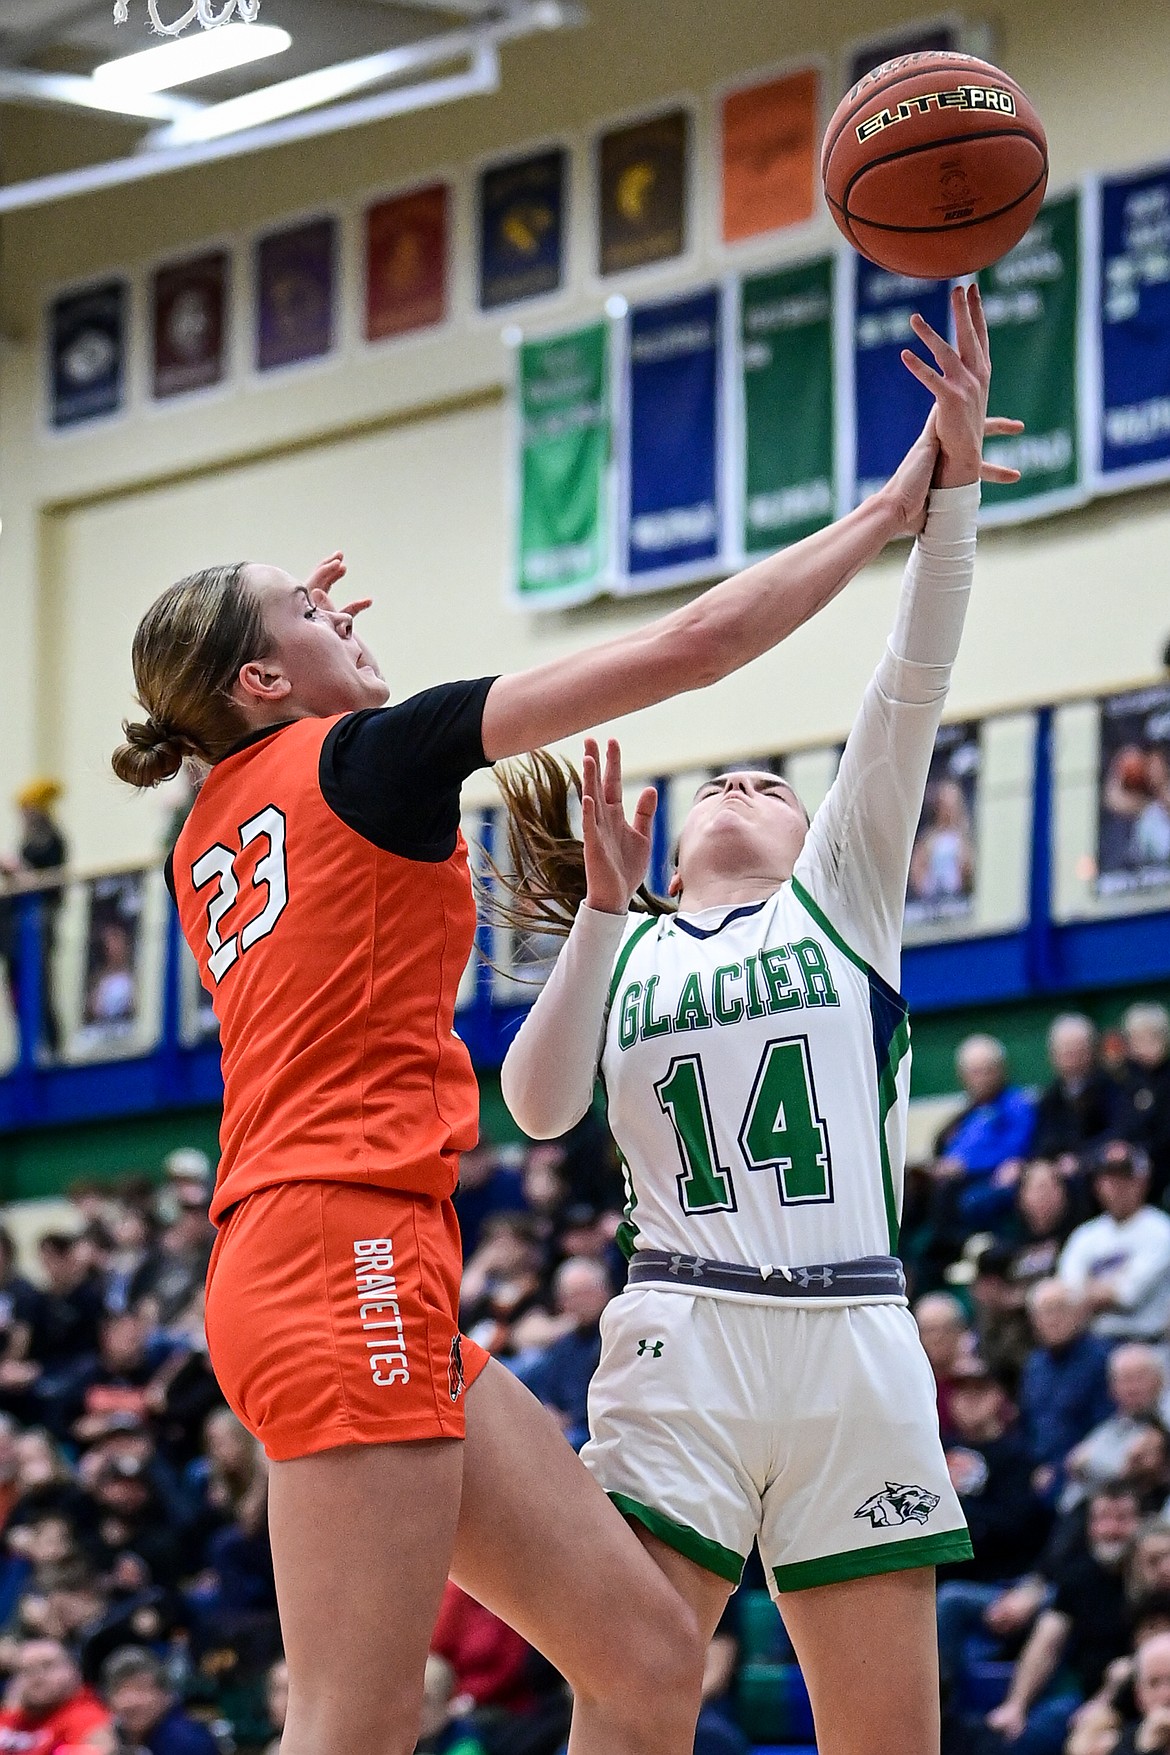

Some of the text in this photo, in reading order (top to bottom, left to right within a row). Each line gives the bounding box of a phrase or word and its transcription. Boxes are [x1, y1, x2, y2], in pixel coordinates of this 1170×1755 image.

[191, 803, 289, 987] 23
[618, 937, 841, 1051] GLACIER
[653, 1034, 835, 1216] 14
[353, 1238, 410, 1386] BRAVETTES
